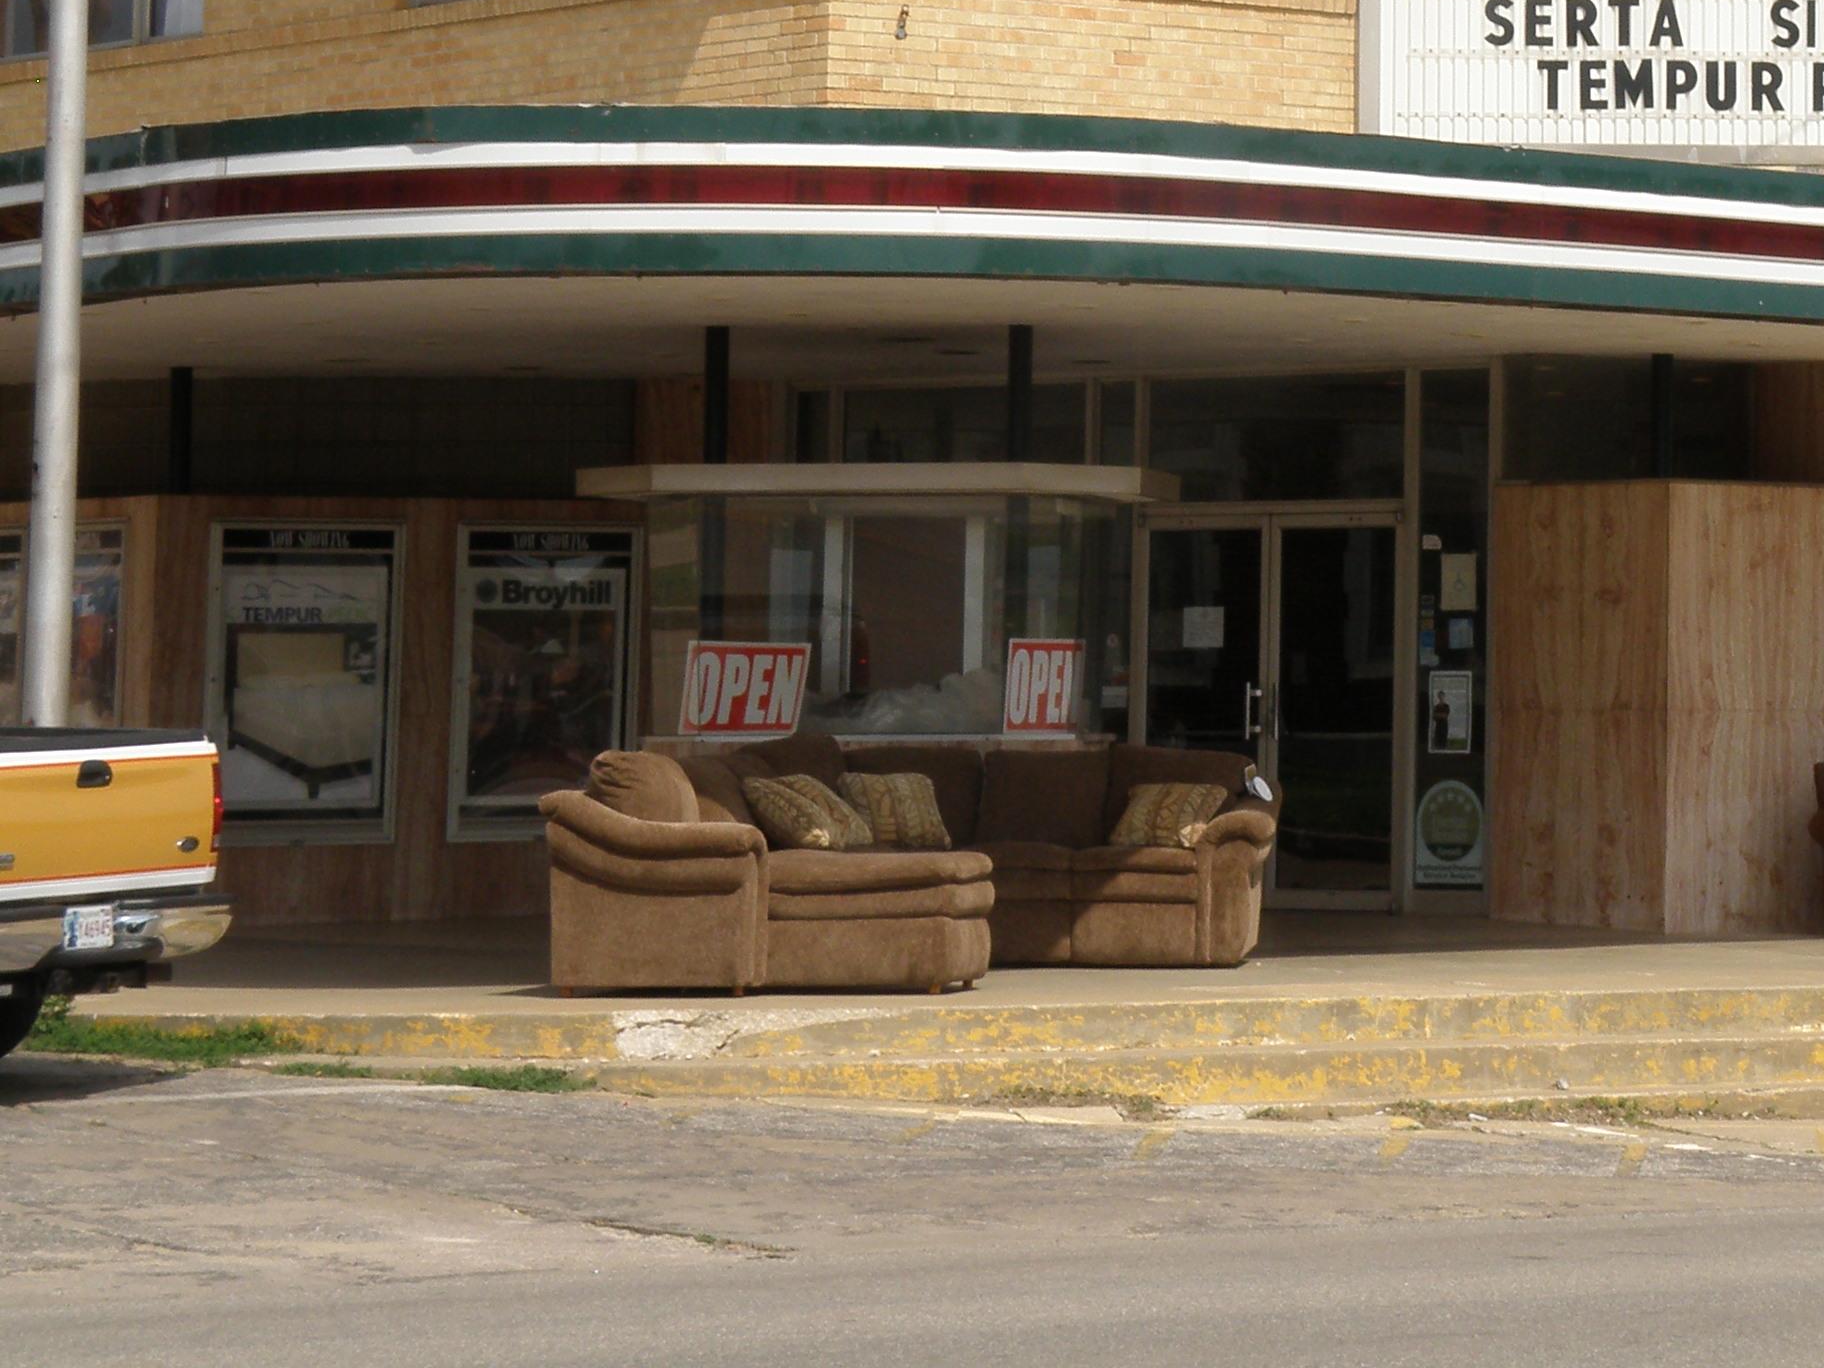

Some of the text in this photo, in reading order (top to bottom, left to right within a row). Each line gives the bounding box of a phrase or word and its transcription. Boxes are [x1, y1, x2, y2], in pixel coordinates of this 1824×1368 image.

[1537, 59, 1784, 111] TEMPUR
[502, 579, 611, 608] Broyhill
[243, 607, 323, 622] TEMPUR
[687, 652, 804, 725] OPEN
